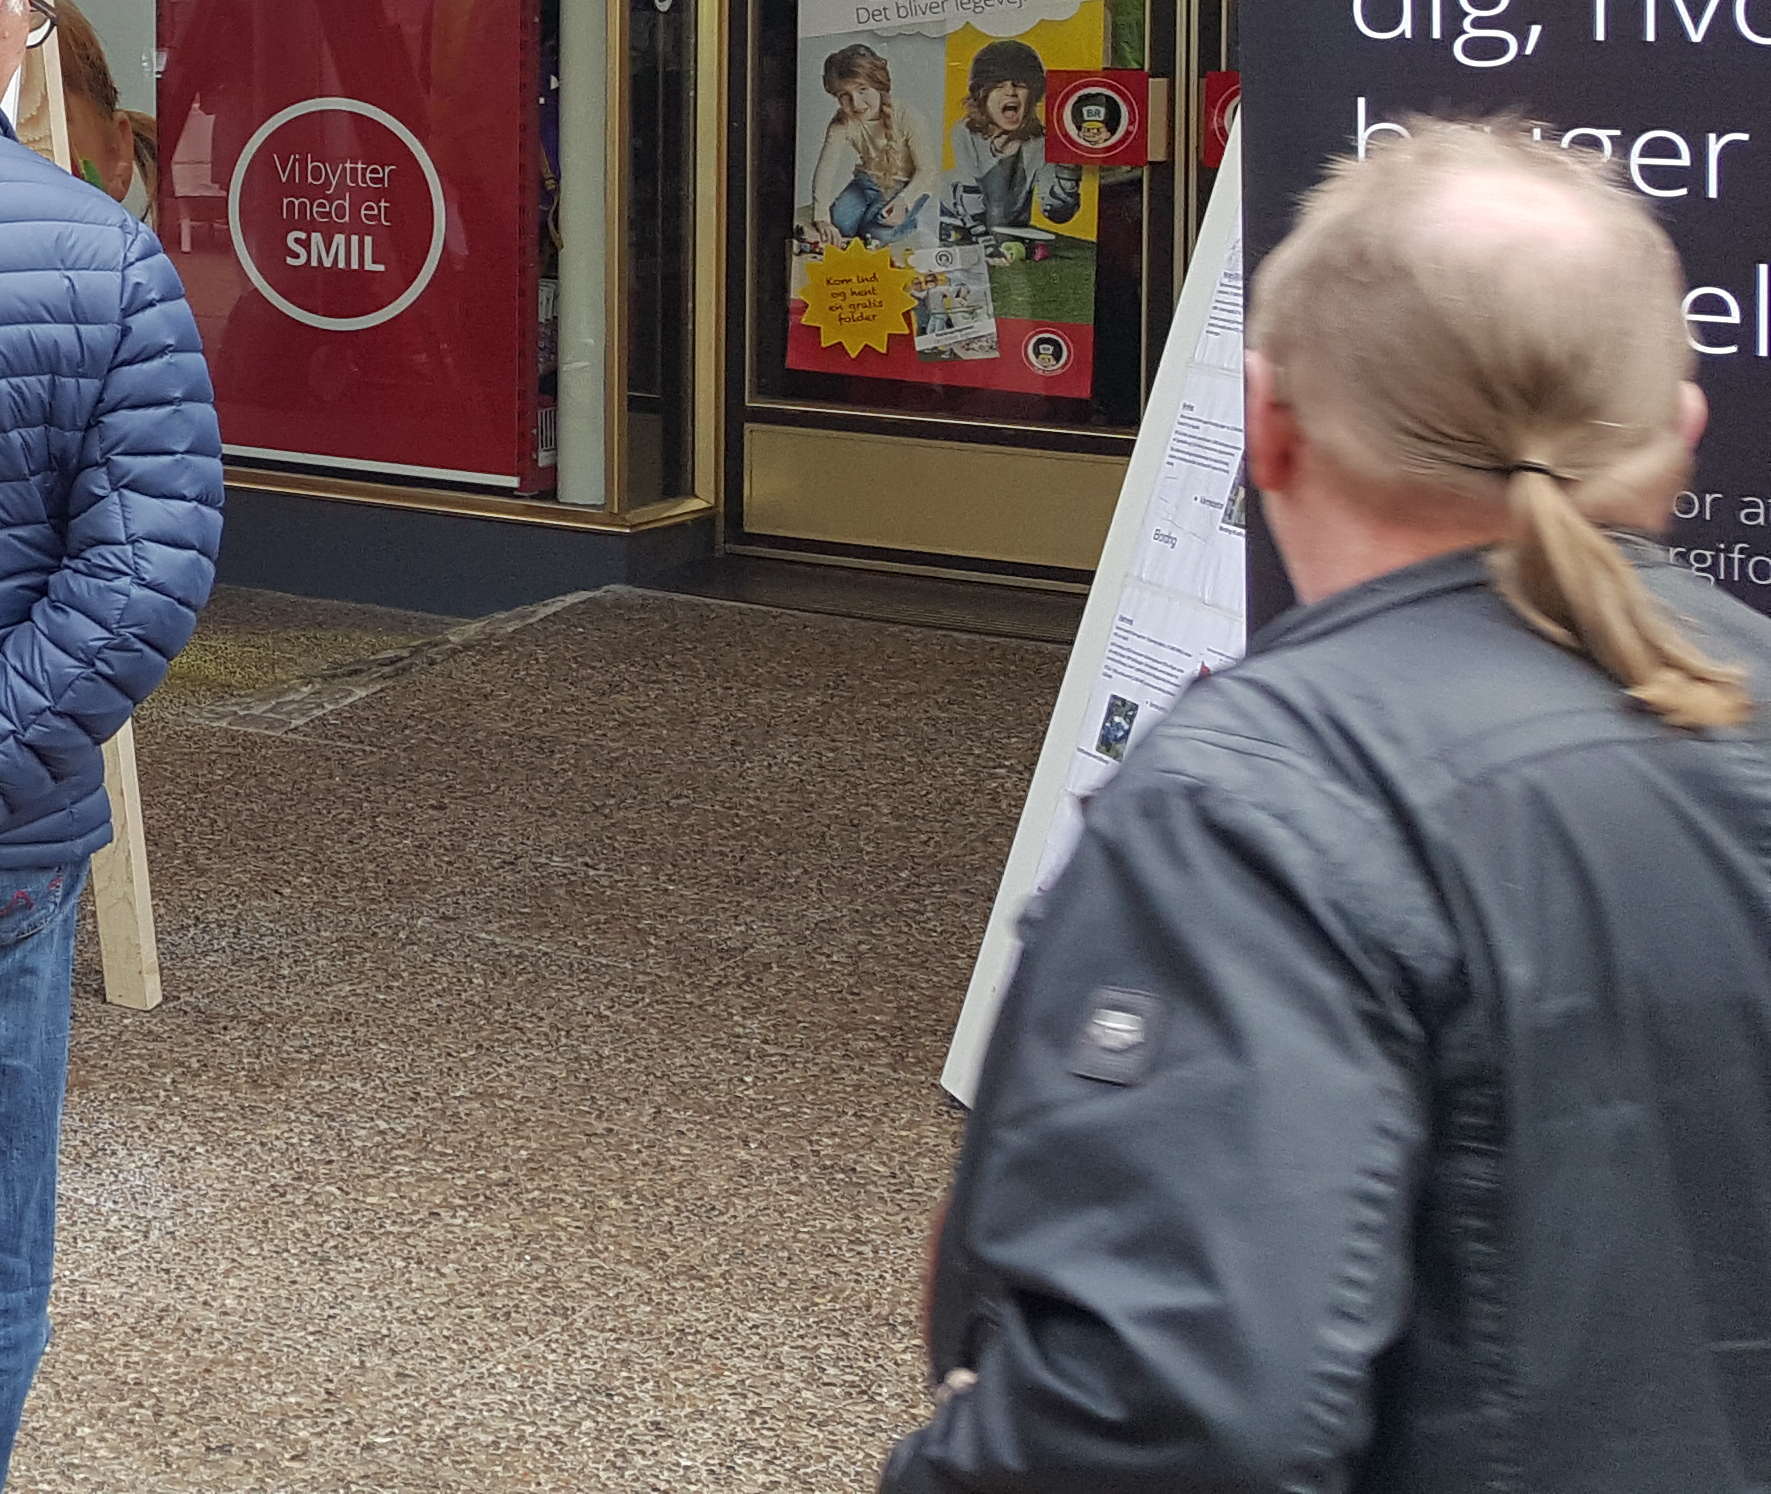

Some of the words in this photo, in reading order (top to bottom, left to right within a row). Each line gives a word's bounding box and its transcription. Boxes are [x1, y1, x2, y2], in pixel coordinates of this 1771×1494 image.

[855, 5, 892, 25] Det
[1086, 108, 1102, 119] BR
[272, 153, 300, 184] Vi
[307, 153, 397, 195] bytter
[282, 192, 350, 223] med
[360, 197, 392, 226] et
[285, 229, 386, 272] SMIL
[830, 291, 847, 302] og
[838, 311, 878, 326] folder
